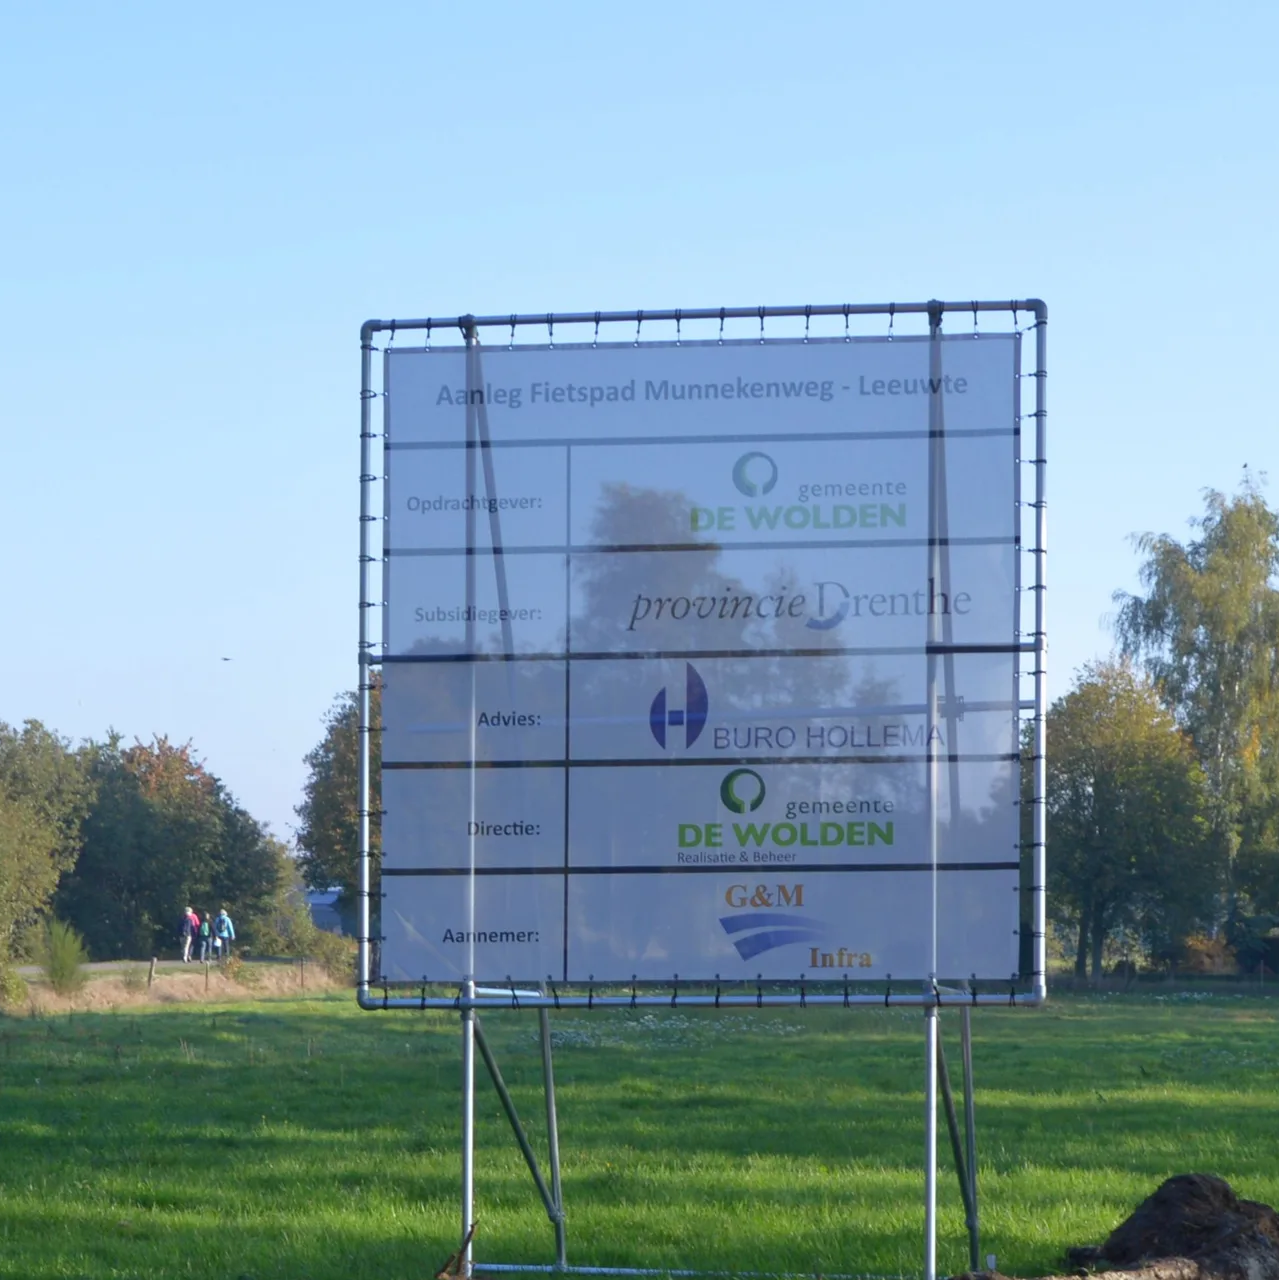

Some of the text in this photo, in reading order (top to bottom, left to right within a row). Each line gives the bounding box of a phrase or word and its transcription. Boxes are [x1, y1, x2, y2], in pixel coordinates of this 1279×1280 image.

[435, 382, 522, 409] Aanleg
[530, 379, 635, 407] Fietspad
[644, 376, 834, 402] Munnekenweg
[858, 374, 968, 397] Leeuwte
[797, 481, 908, 503] gemeente
[406, 494, 543, 515] Opdrachtgever:
[690, 502, 908, 533] DE WOLDEN
[413, 605, 543, 625] Subsidiegever:
[624, 577, 973, 632] provincie Drenthe
[477, 710, 542, 728] Advies:
[713, 723, 946, 749] BURO HOLLEMA
[785, 799, 895, 820] gemeente
[467, 820, 541, 836] Directie:
[678, 821, 894, 848] DE WOLDEN
[677, 850, 797, 864] Realisatie & Beheer
[725, 883, 805, 908] G&M
[442, 928, 540, 943] Aannemer:
[808, 947, 873, 969] Infra
